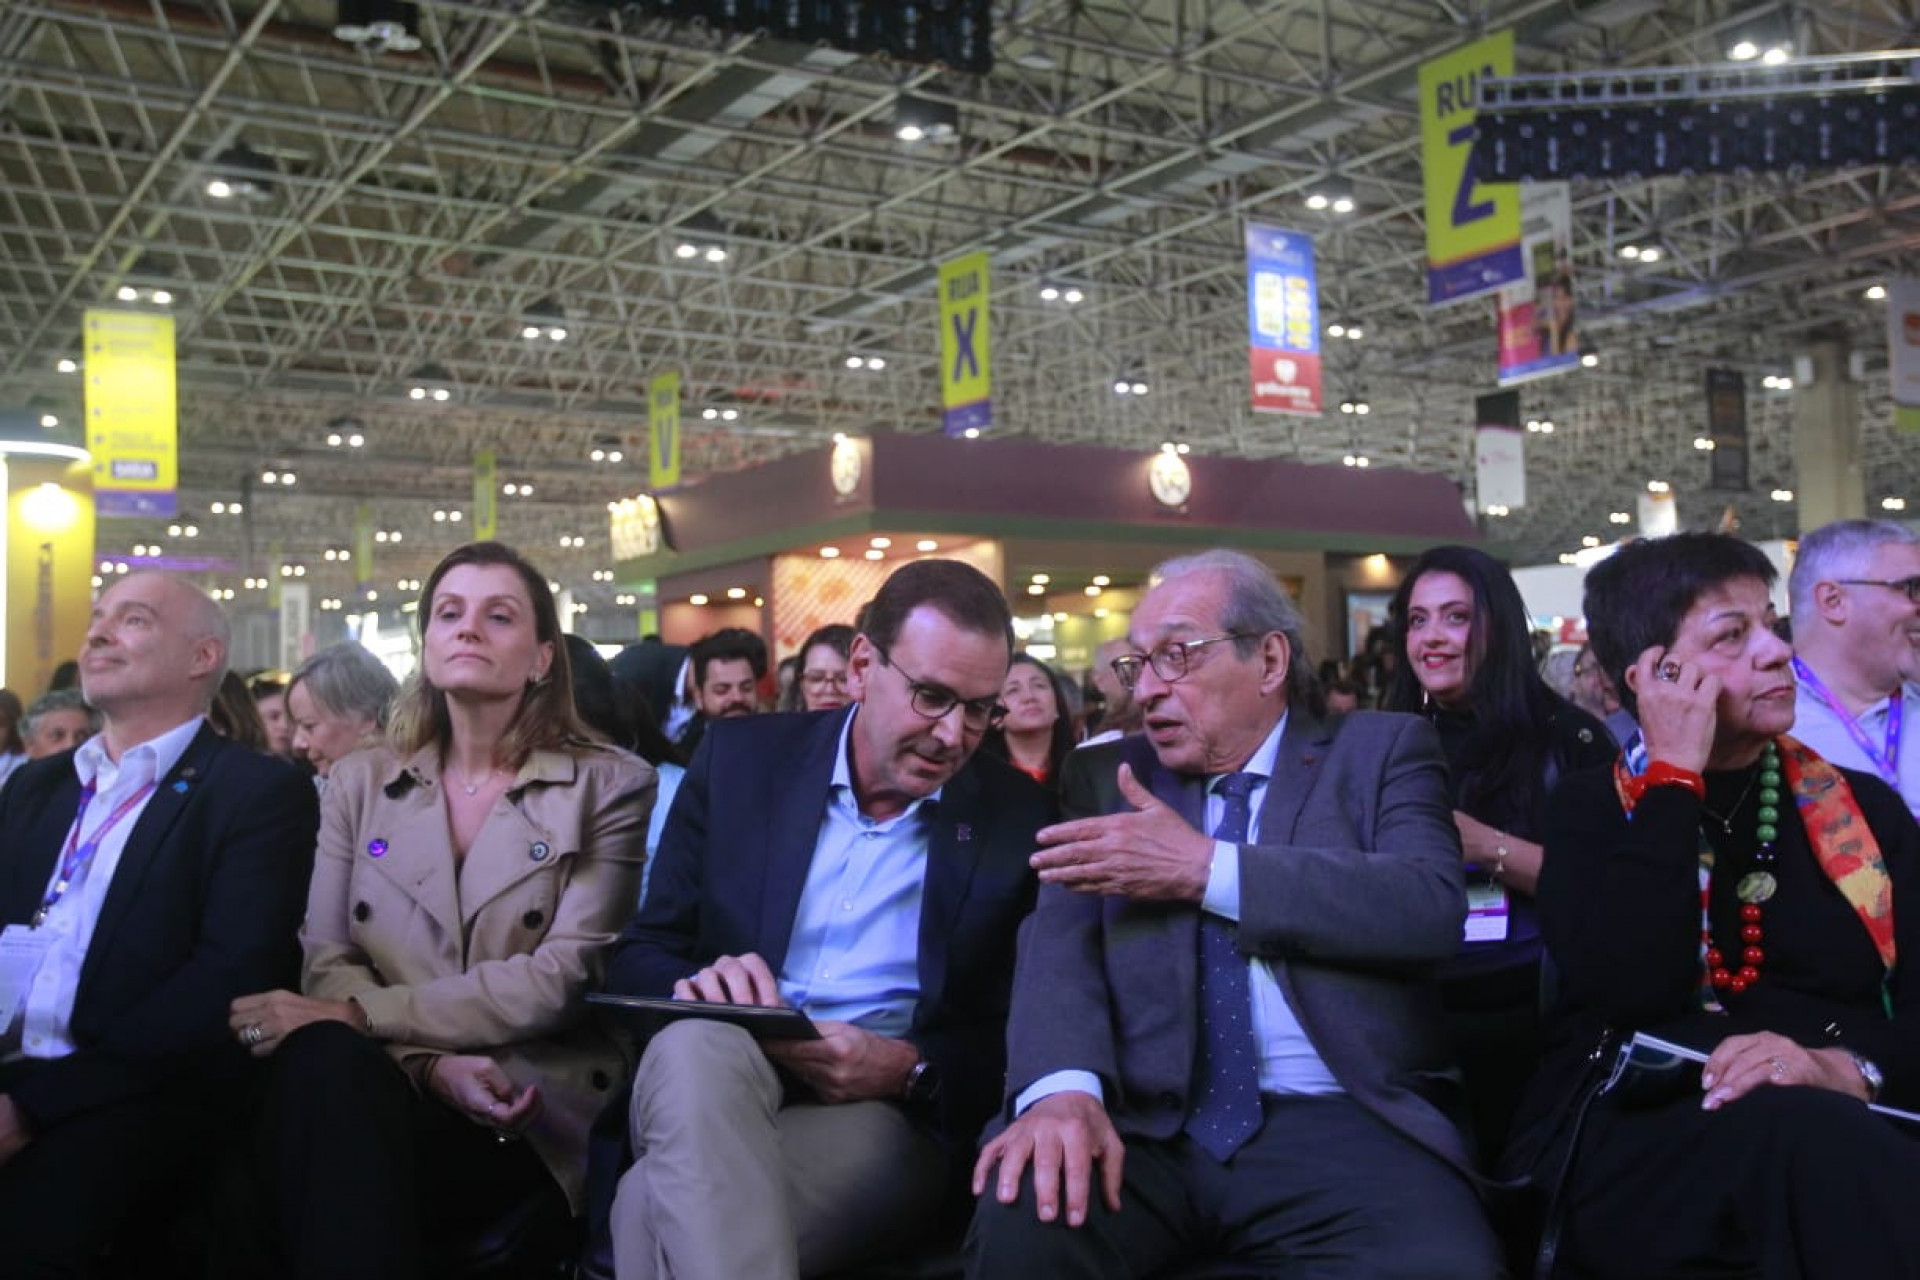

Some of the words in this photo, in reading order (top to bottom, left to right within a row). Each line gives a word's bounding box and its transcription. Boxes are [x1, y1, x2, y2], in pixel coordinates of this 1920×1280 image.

[1436, 65, 1493, 119] RU
[1447, 122, 1496, 227] Z
[949, 270, 980, 301] RUA
[953, 307, 979, 383] X
